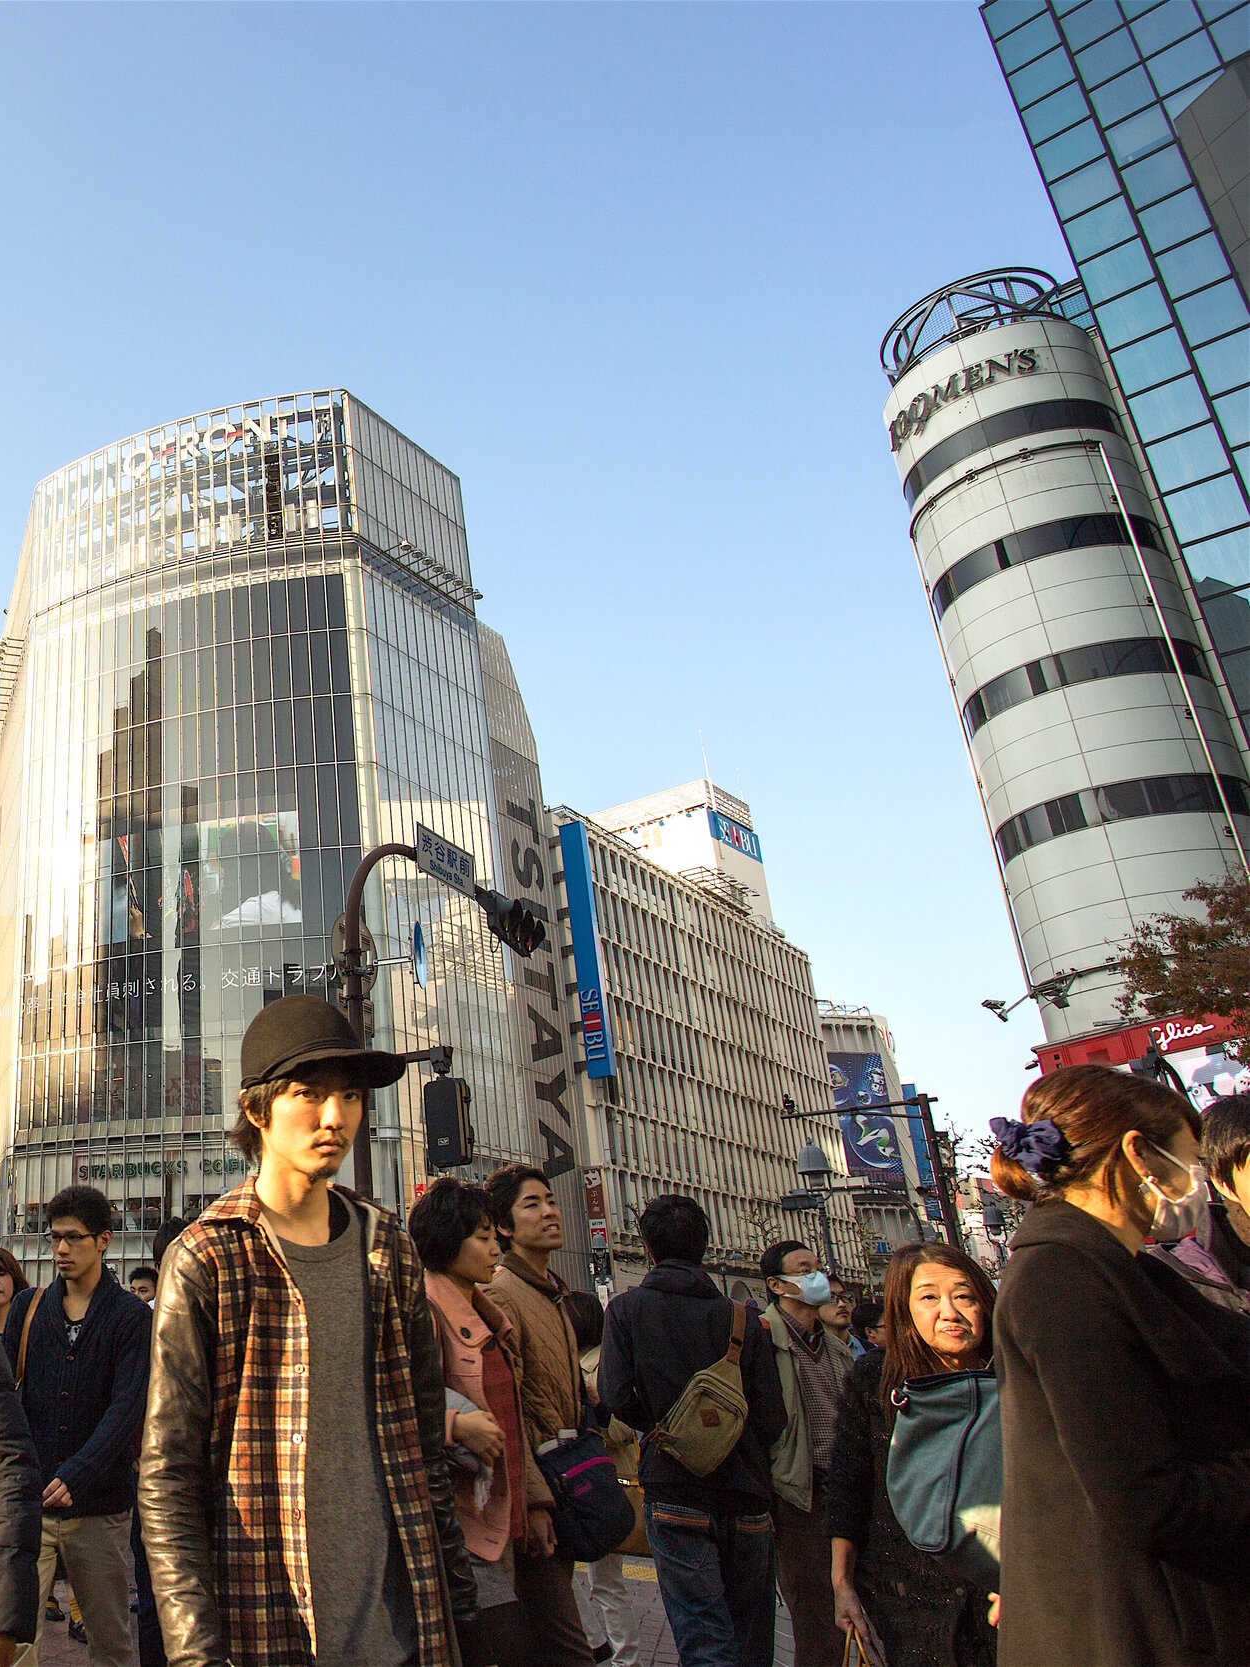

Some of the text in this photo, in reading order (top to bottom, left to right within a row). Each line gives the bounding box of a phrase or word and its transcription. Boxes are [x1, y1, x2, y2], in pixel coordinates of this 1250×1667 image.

[422, 832, 470, 878] 渋谷駅前
[430, 859, 453, 881] Shibuya
[1152, 1022, 1214, 1051] Glico
[78, 1159, 188, 1180] STARBUCKS
